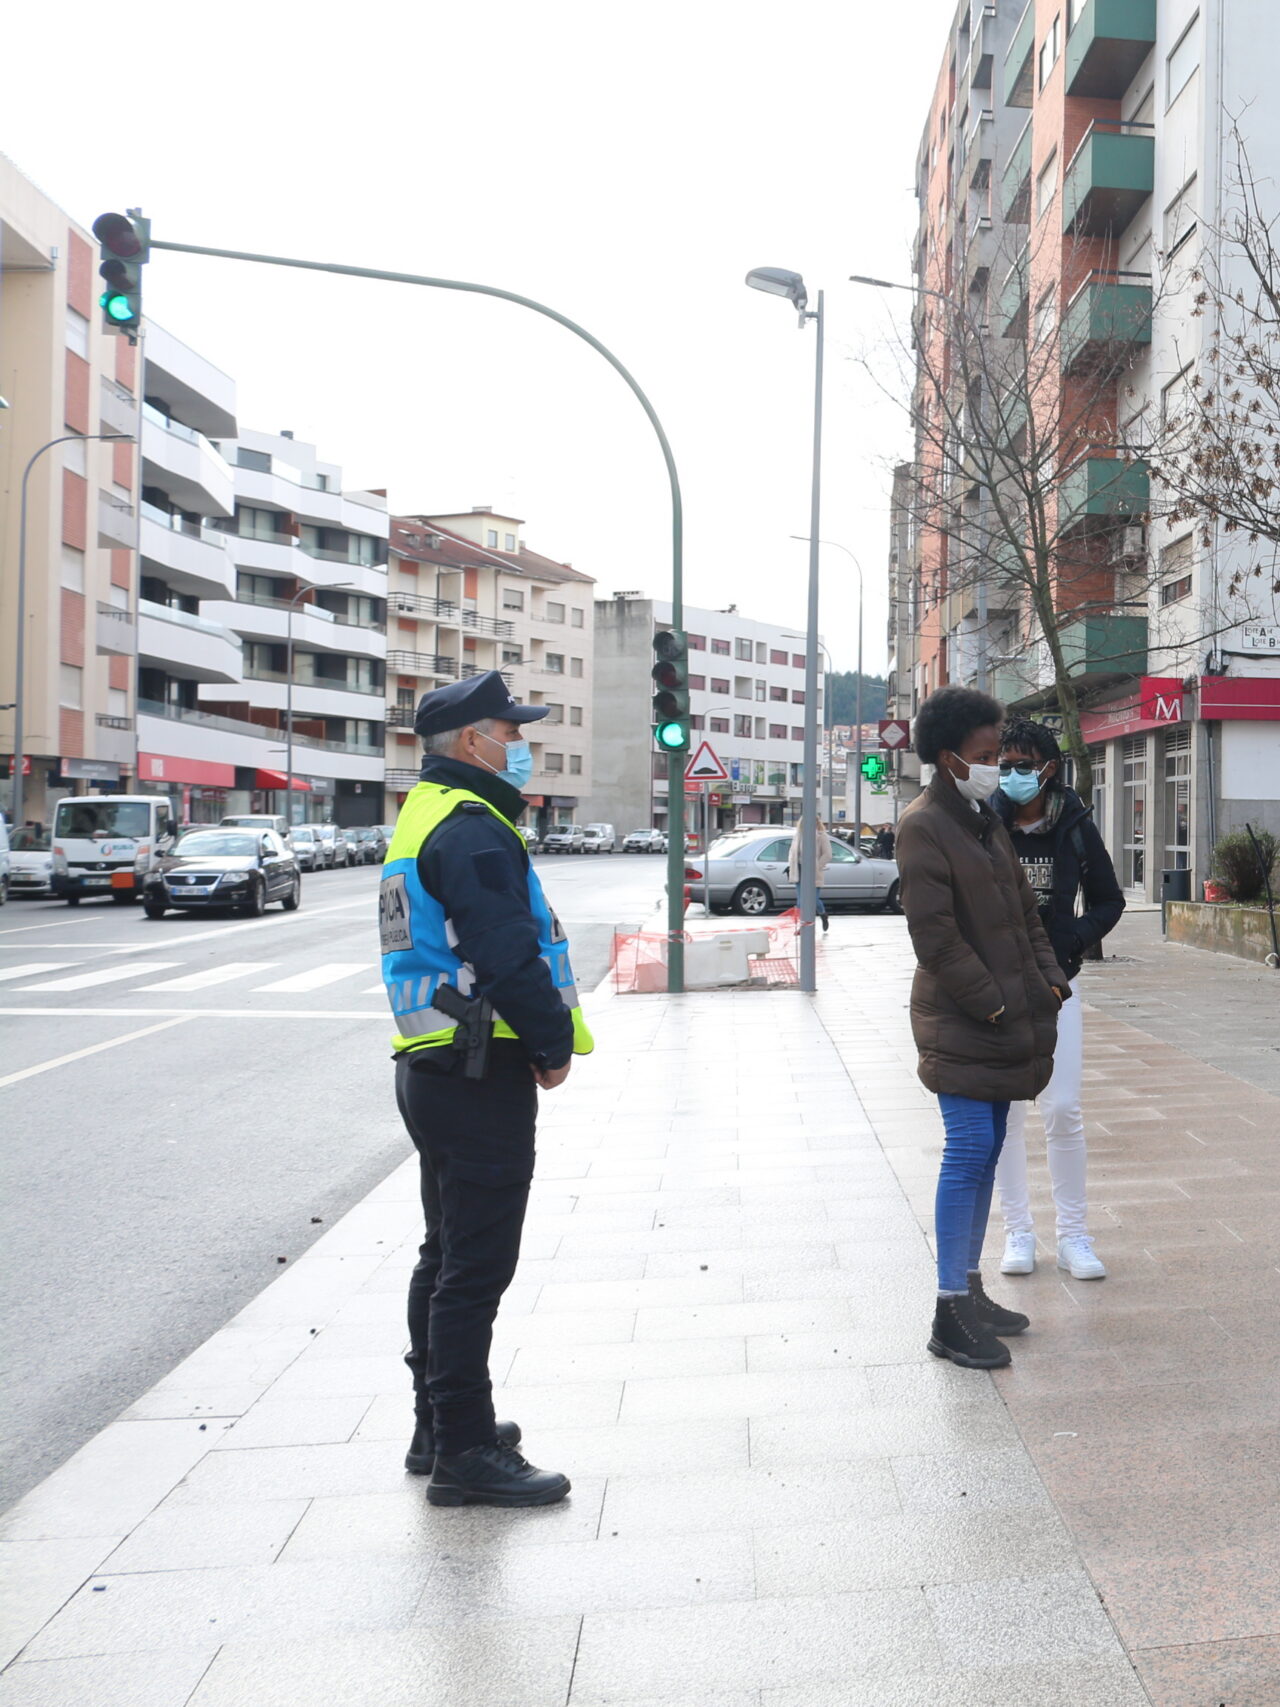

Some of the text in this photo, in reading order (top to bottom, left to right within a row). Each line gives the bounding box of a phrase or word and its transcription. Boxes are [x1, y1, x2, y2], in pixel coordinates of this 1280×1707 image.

[1260, 627, 1267, 637] A
[1269, 638, 1276, 647] B
[1154, 693, 1181, 720] M
